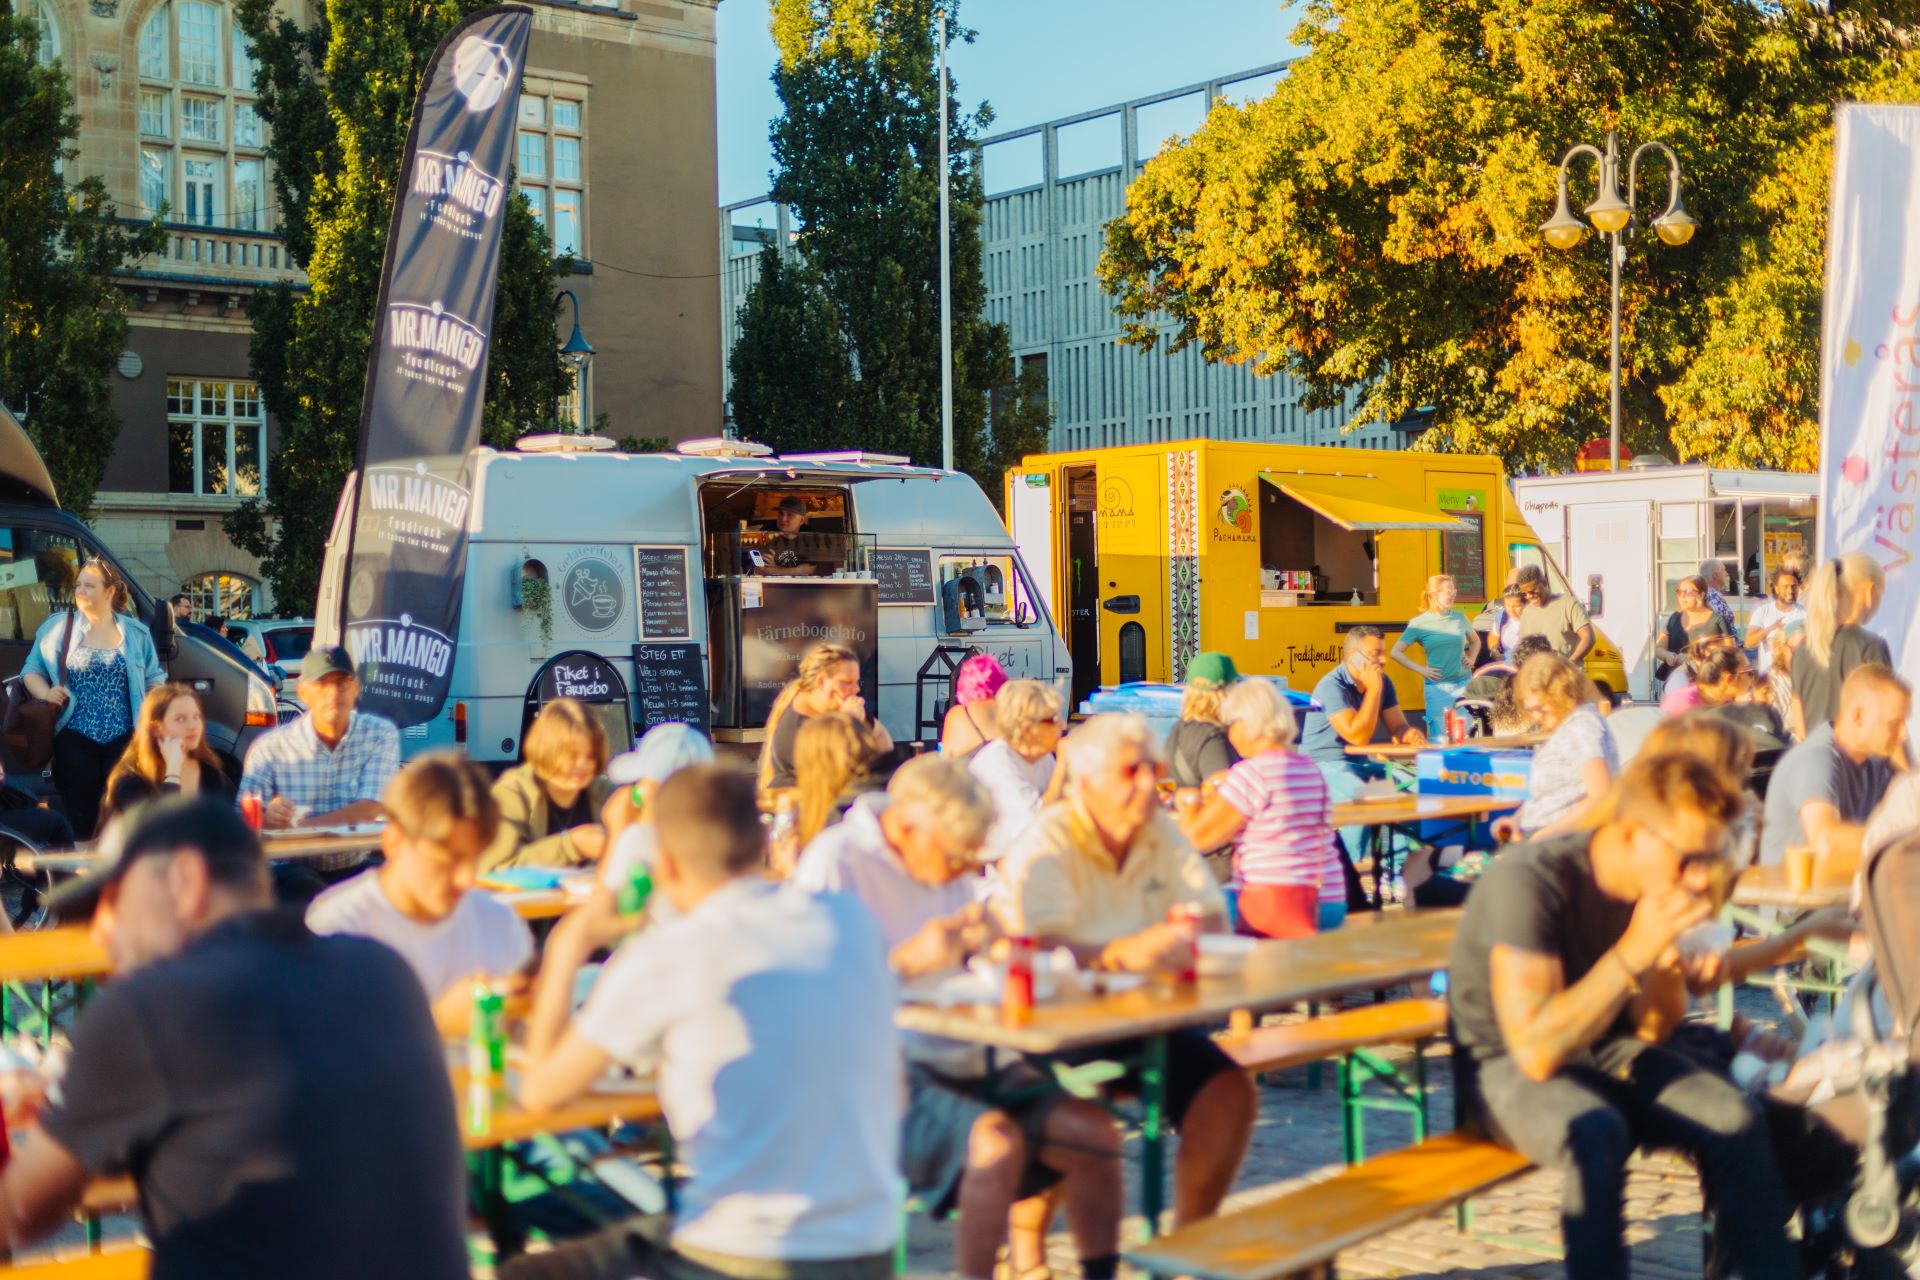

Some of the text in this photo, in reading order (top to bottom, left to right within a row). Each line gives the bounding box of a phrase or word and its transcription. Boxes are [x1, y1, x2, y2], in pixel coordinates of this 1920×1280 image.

[391, 310, 483, 371] MR.MANGO
[369, 474, 468, 528] MR.MANGO
[1072, 608, 1090, 617] STER
[757, 622, 866, 642] Färnebogelato
[350, 628, 451, 677] MR.MANGO
[640, 645, 687, 660] STEG ETT
[1287, 643, 1337, 674] Traditionell
[554, 665, 600, 681] Fiket i
[555, 681, 609, 697] Färnebo
